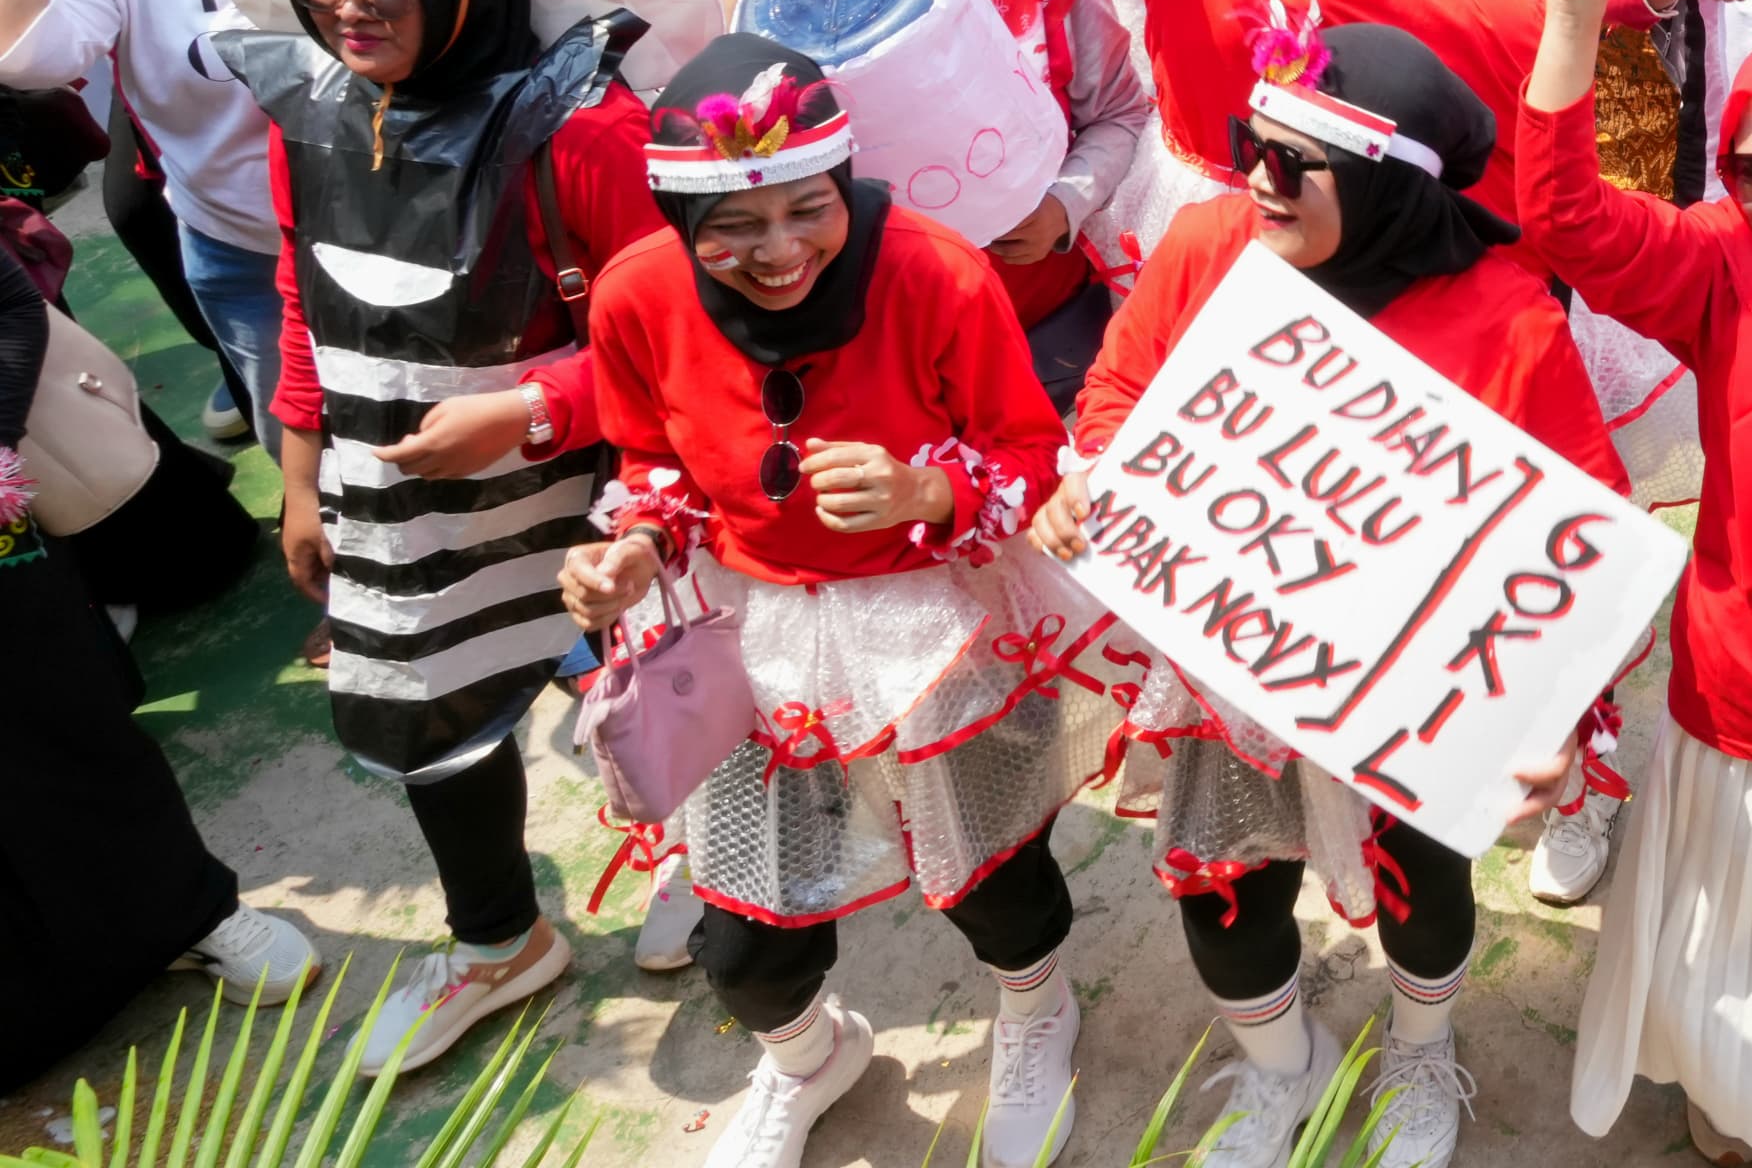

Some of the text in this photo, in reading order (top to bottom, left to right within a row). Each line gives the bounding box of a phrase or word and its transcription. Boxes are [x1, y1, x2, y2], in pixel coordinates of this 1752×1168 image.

[1248, 315, 1358, 389] BU
[1121, 431, 1358, 595] BU OKY
[1177, 368, 1422, 546] BU LULU
[1090, 489, 1209, 607] MBAK
